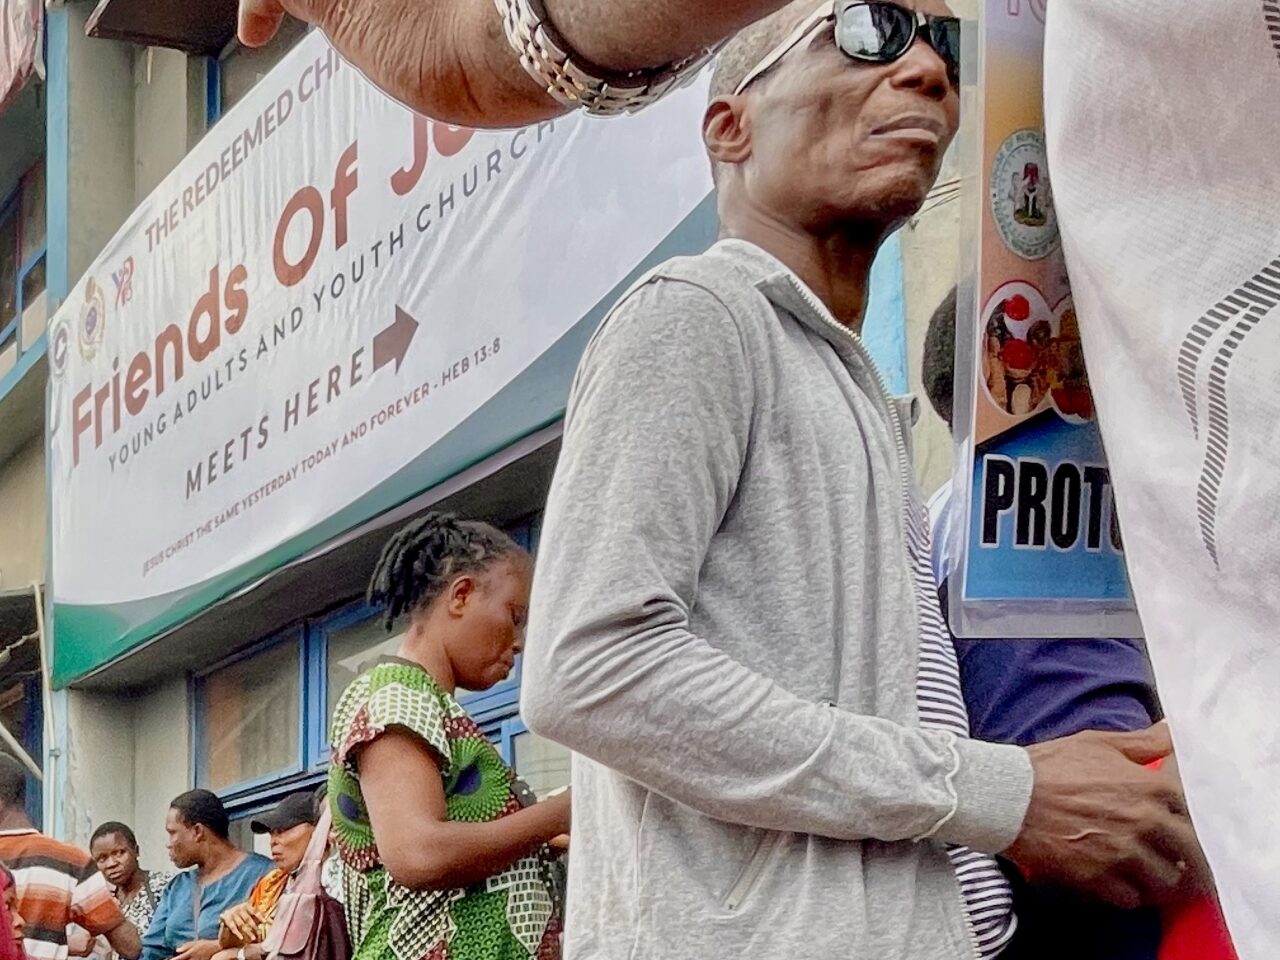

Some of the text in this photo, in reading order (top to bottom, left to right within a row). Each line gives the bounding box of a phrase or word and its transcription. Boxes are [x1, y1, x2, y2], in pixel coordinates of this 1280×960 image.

[145, 199, 179, 253] THE
[183, 89, 294, 219] REDEEMED
[72, 264, 249, 469] Friends
[273, 139, 359, 288] Of
[109, 413, 167, 473] YOUNG
[173, 348, 248, 425] ADULTS
[256, 306, 303, 360] AND
[313, 223, 404, 312] YOUTH
[165, 531, 195, 558] CHRIST
[195, 519, 213, 539] THE
[214, 502, 240, 529] SAME
[241, 464, 299, 510] YESTERDAY
[301, 439, 339, 474] TODAY
[341, 421, 368, 449] AND
[370, 382, 430, 431] FOREVER
[441, 358, 470, 387] HEB
[473, 336, 502, 366] 13:8
[186, 346, 365, 500] MEETS HERE
